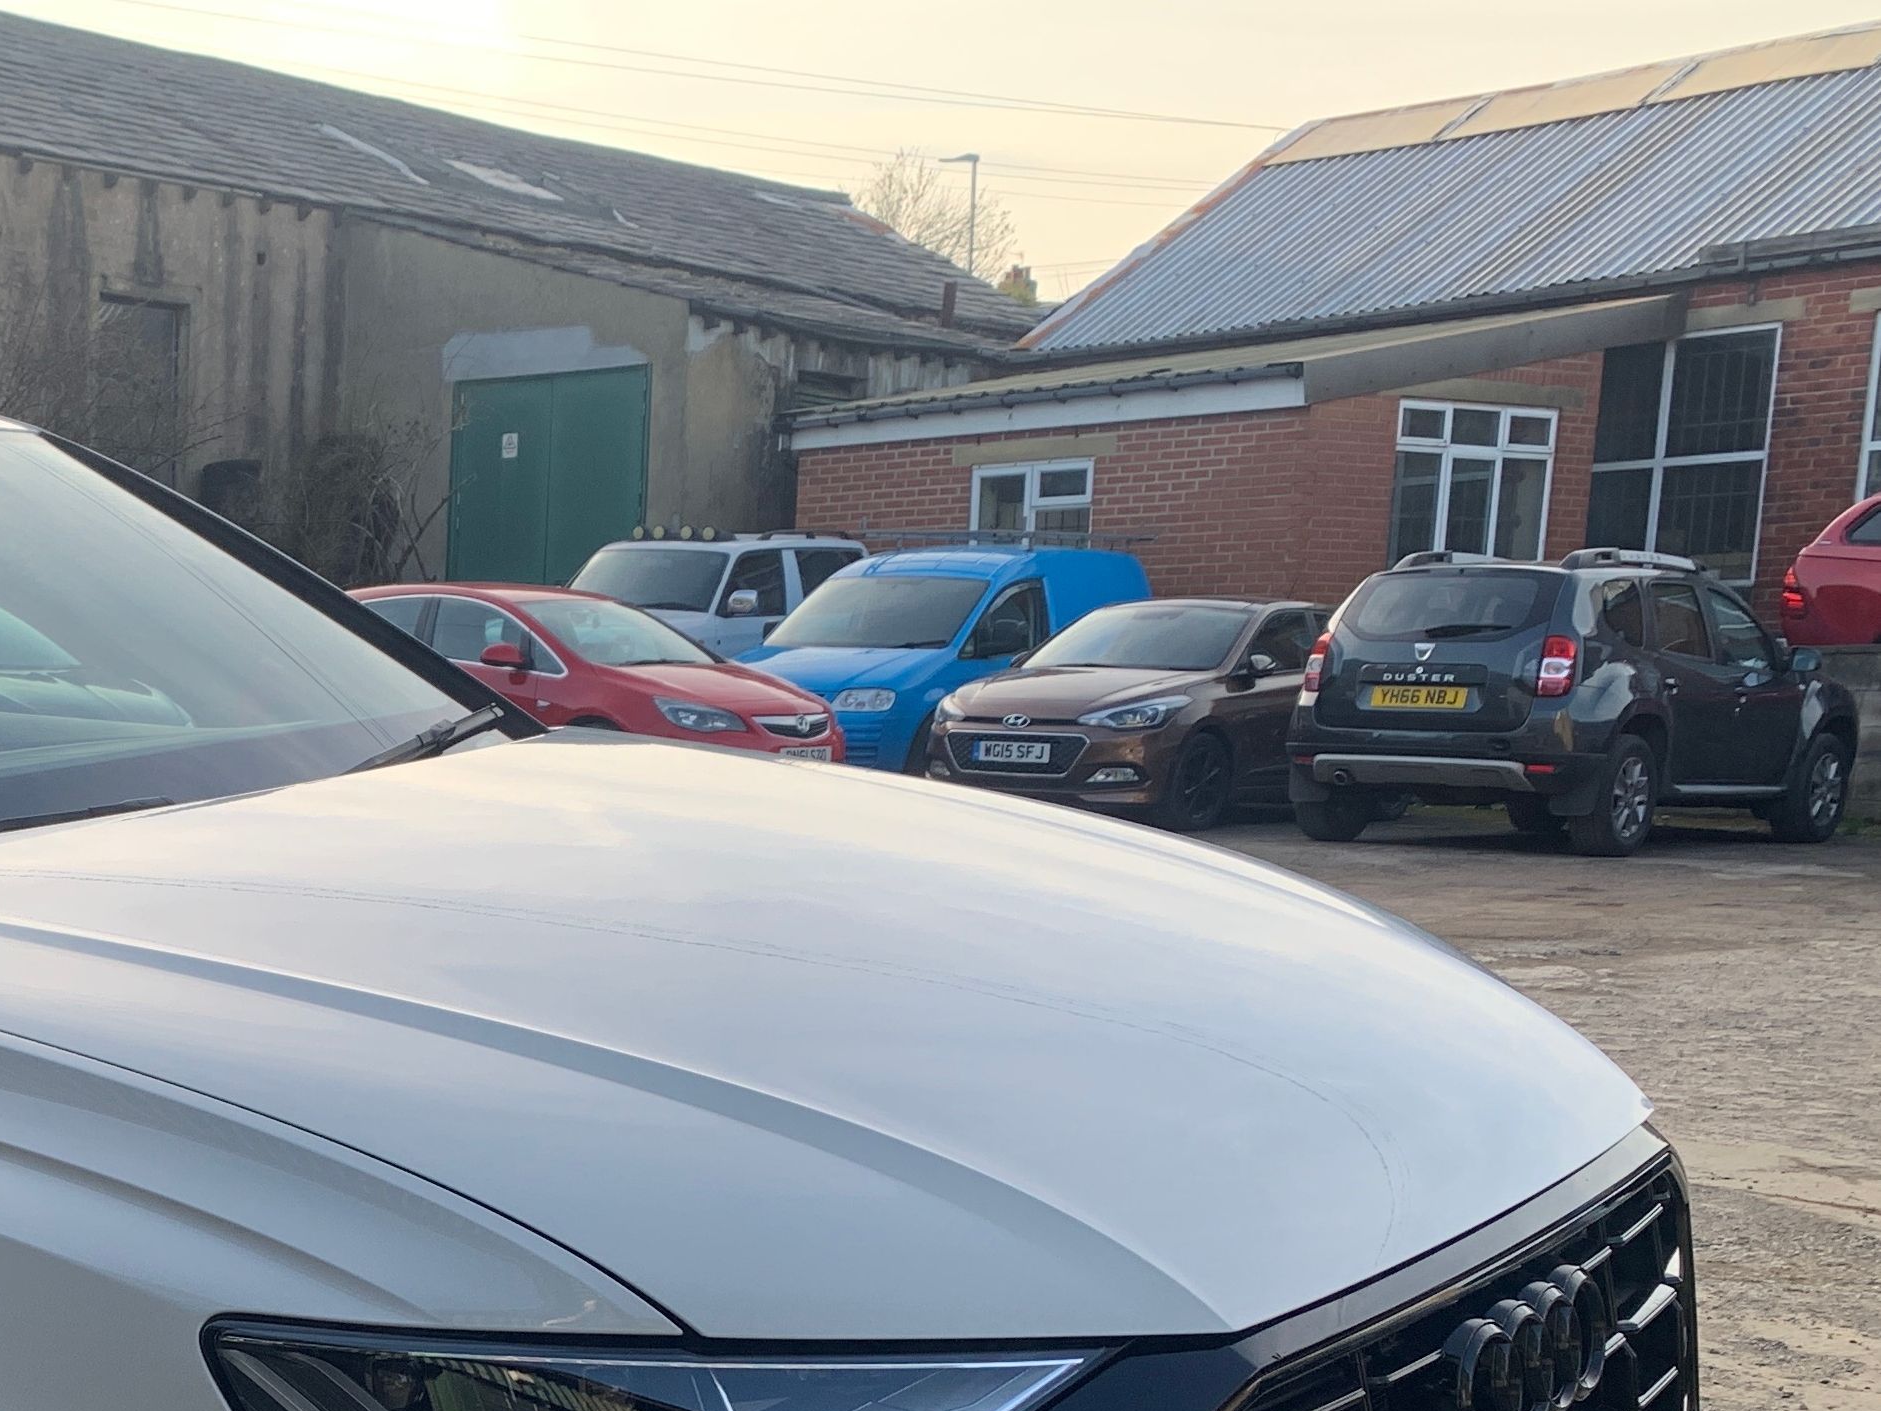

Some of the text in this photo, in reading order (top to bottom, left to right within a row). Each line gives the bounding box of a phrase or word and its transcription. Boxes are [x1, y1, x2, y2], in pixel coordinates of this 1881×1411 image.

[1382, 672, 1456, 683] DUSTER
[1381, 689, 1460, 706] YH66 NBJ
[984, 743, 1045, 760] WG15 SFJ
